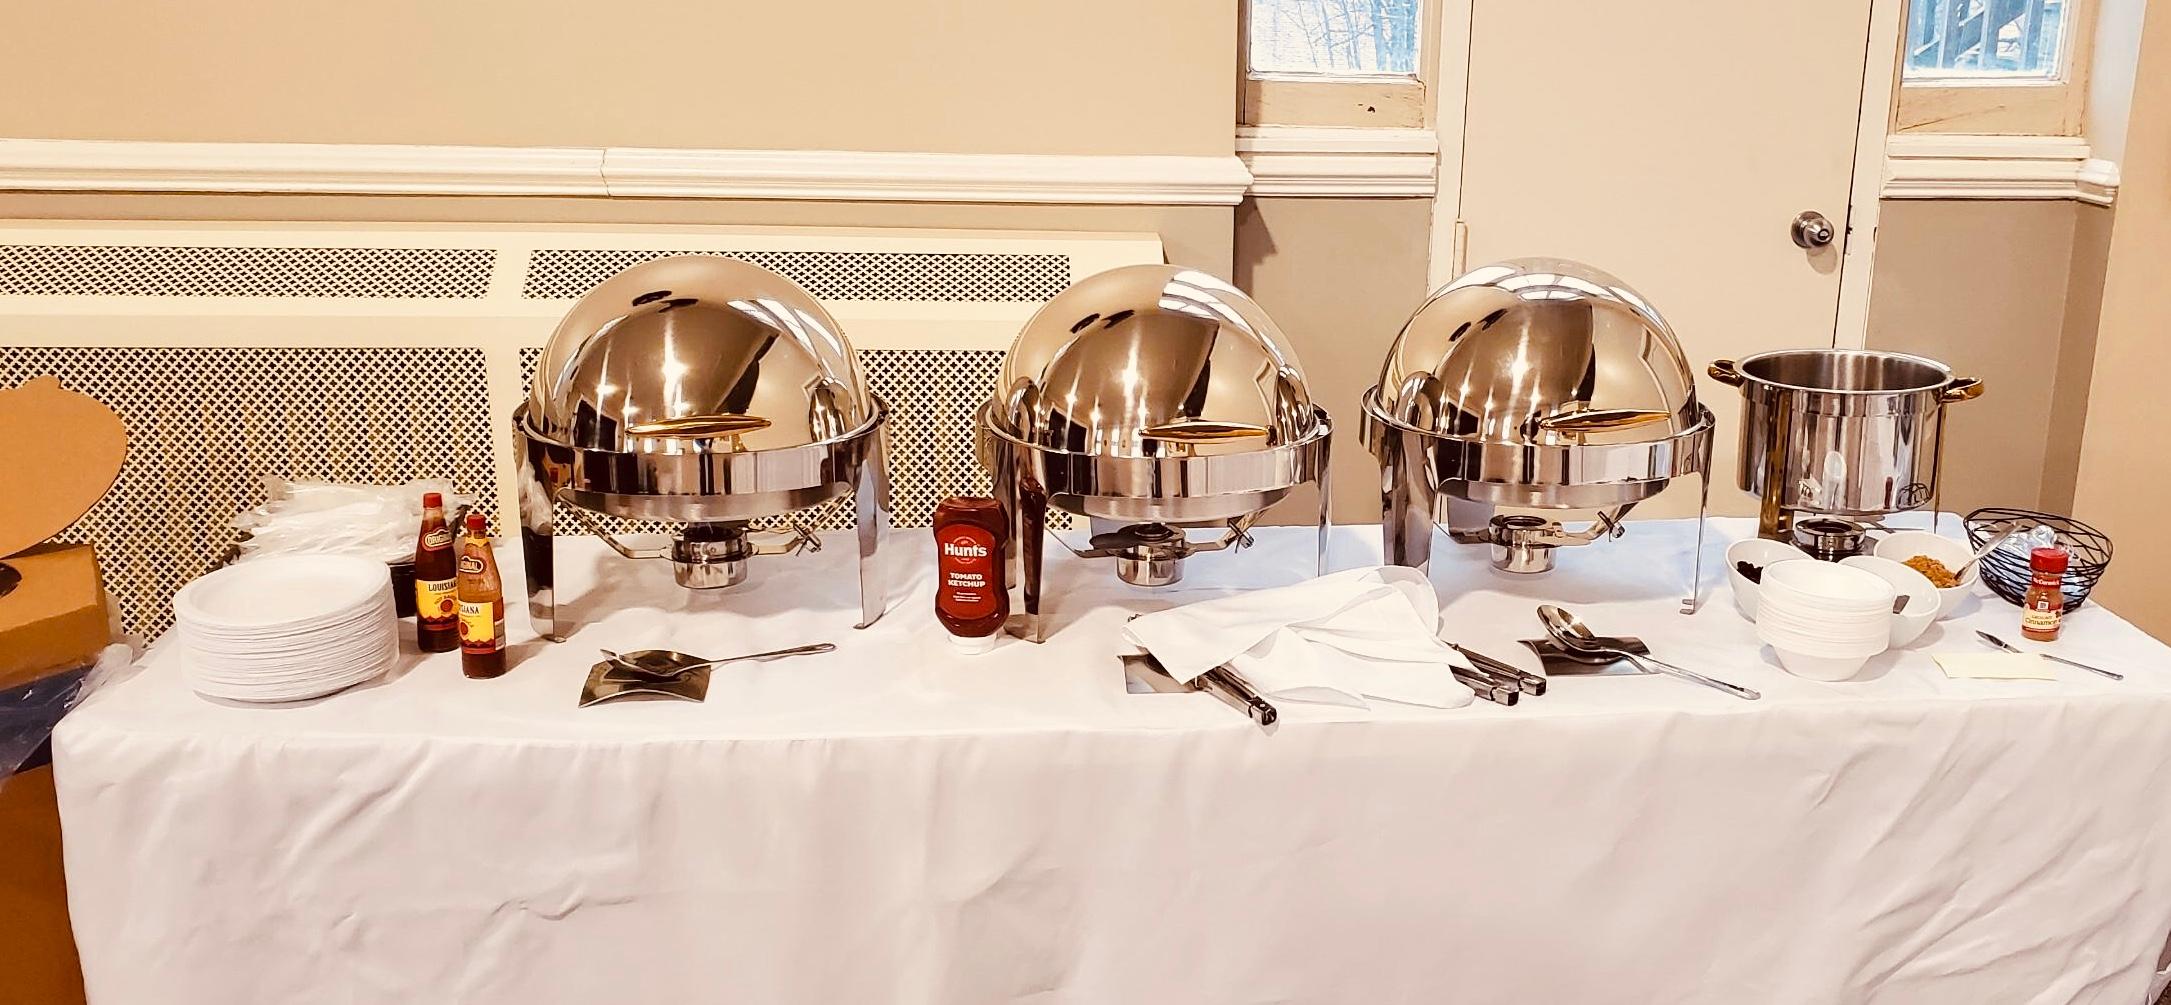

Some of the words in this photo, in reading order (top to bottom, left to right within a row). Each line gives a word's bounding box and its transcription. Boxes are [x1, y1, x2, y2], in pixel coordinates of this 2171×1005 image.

[944, 543, 987, 557] Hunt's
[950, 572, 982, 580] TOMATO
[948, 579, 985, 588] KETCHUP
